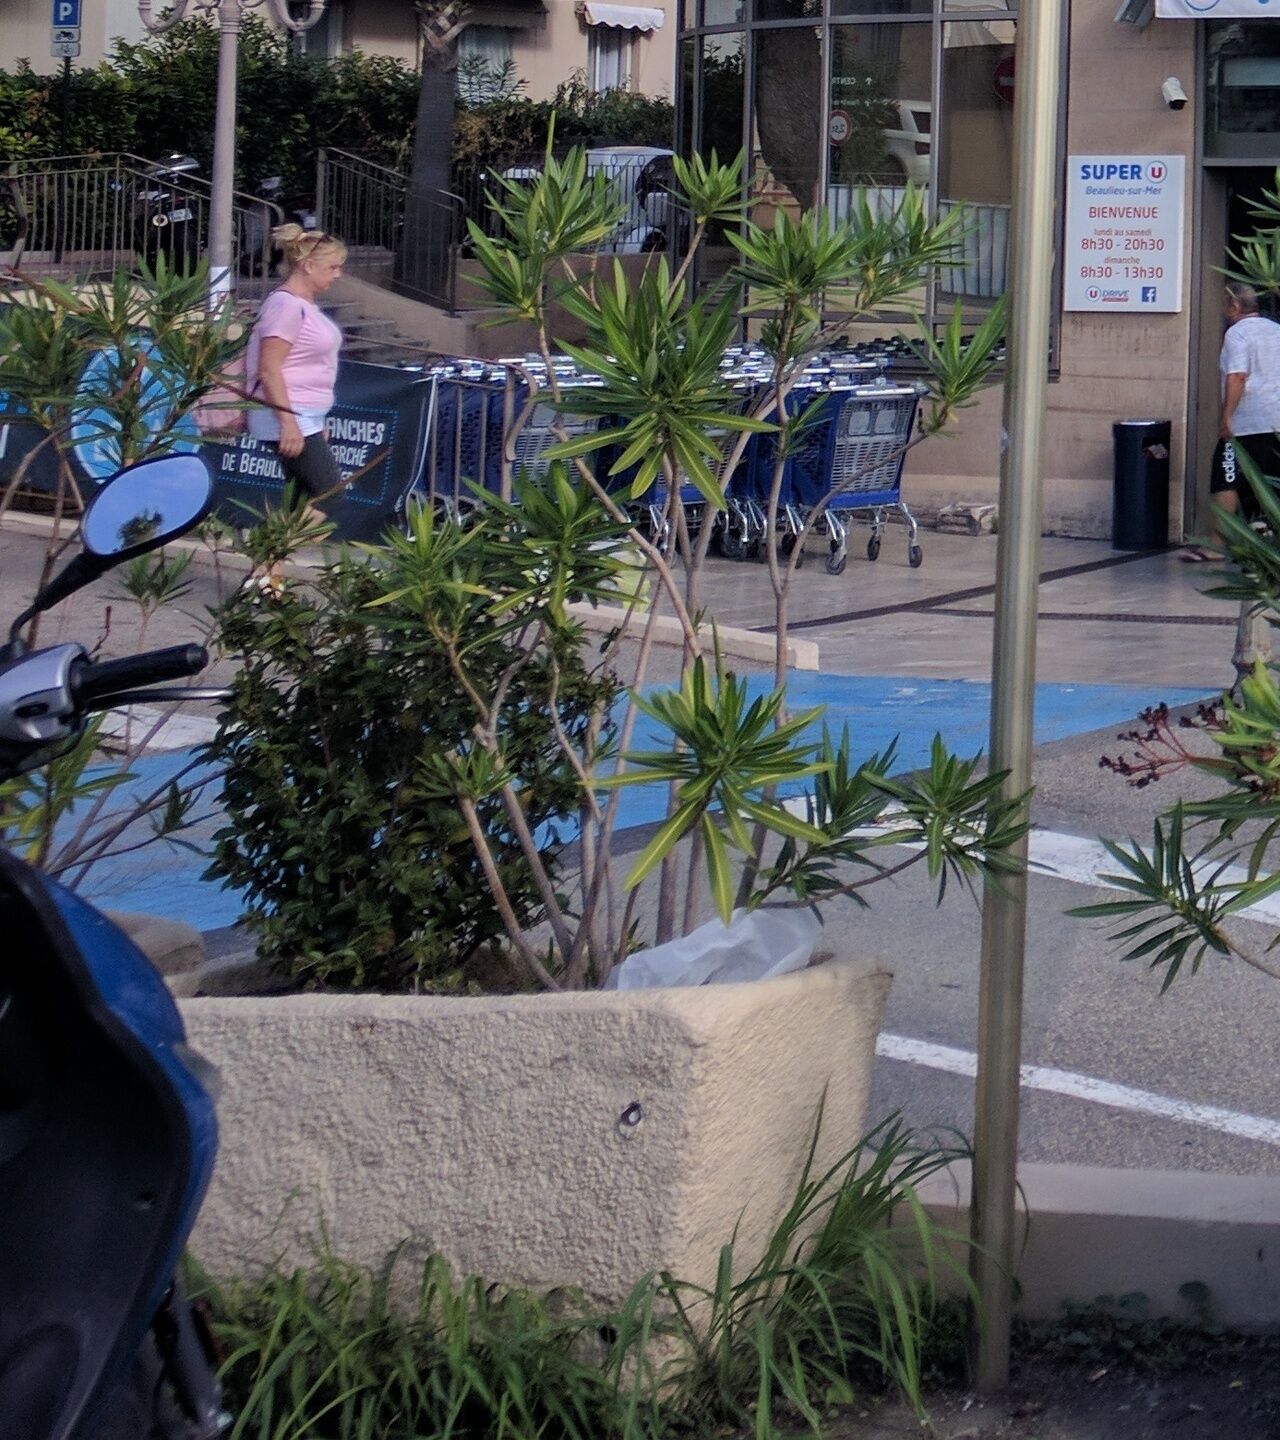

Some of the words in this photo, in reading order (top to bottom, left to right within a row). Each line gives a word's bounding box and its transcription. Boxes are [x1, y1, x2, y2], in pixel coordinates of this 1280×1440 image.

[60, 2, 73, 21] P
[1081, 164, 1143, 180] SUPER
[1085, 186, 1162, 195] Beaulieu-sur-Mer
[1088, 206, 1159, 219] BIENVENUE
[1094, 228, 1112, 236] lundi
[1125, 228, 1153, 236] samedi
[1080, 238, 1113, 250] 8h30
[1124, 238, 1165, 251] 20h30
[1104, 256, 1141, 265] dimanche
[1080, 266, 1113, 278] 8h30
[1124, 267, 1164, 278] 13h30
[221, 452, 236, 472] DE
